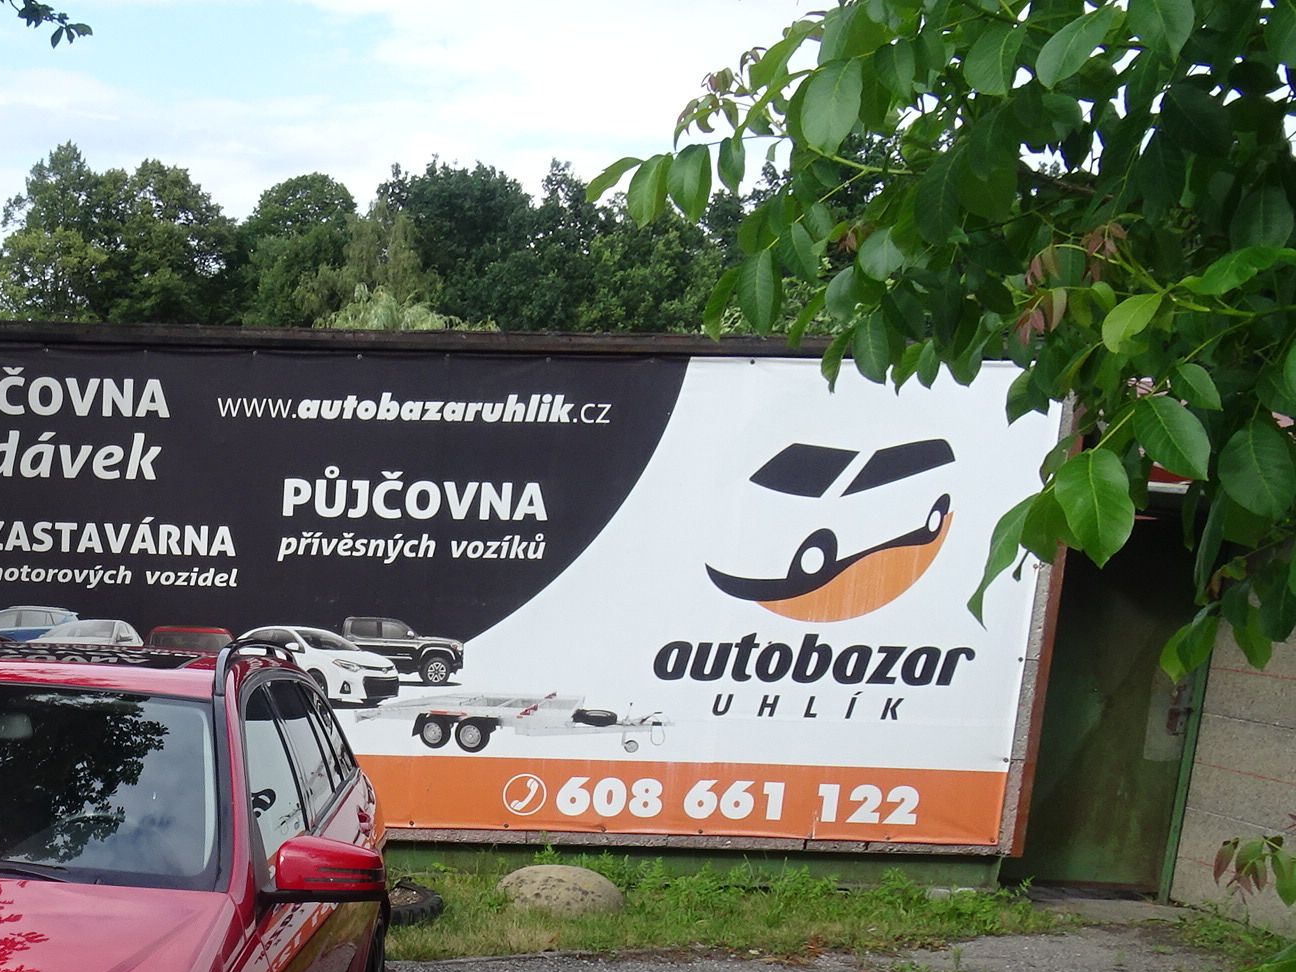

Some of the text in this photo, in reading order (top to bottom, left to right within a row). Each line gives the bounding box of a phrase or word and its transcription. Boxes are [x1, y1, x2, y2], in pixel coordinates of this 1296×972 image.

[217, 391, 612, 424] www.autobazaruhlik.cz
[282, 465, 548, 521] PŮJČOVNA
[277, 531, 546, 564] přívěsných vozíků
[145, 567, 238, 587] vozidel
[653, 632, 976, 687] autobazar
[712, 691, 905, 721] UHLÍK
[555, 776, 920, 825] 608 661 122
